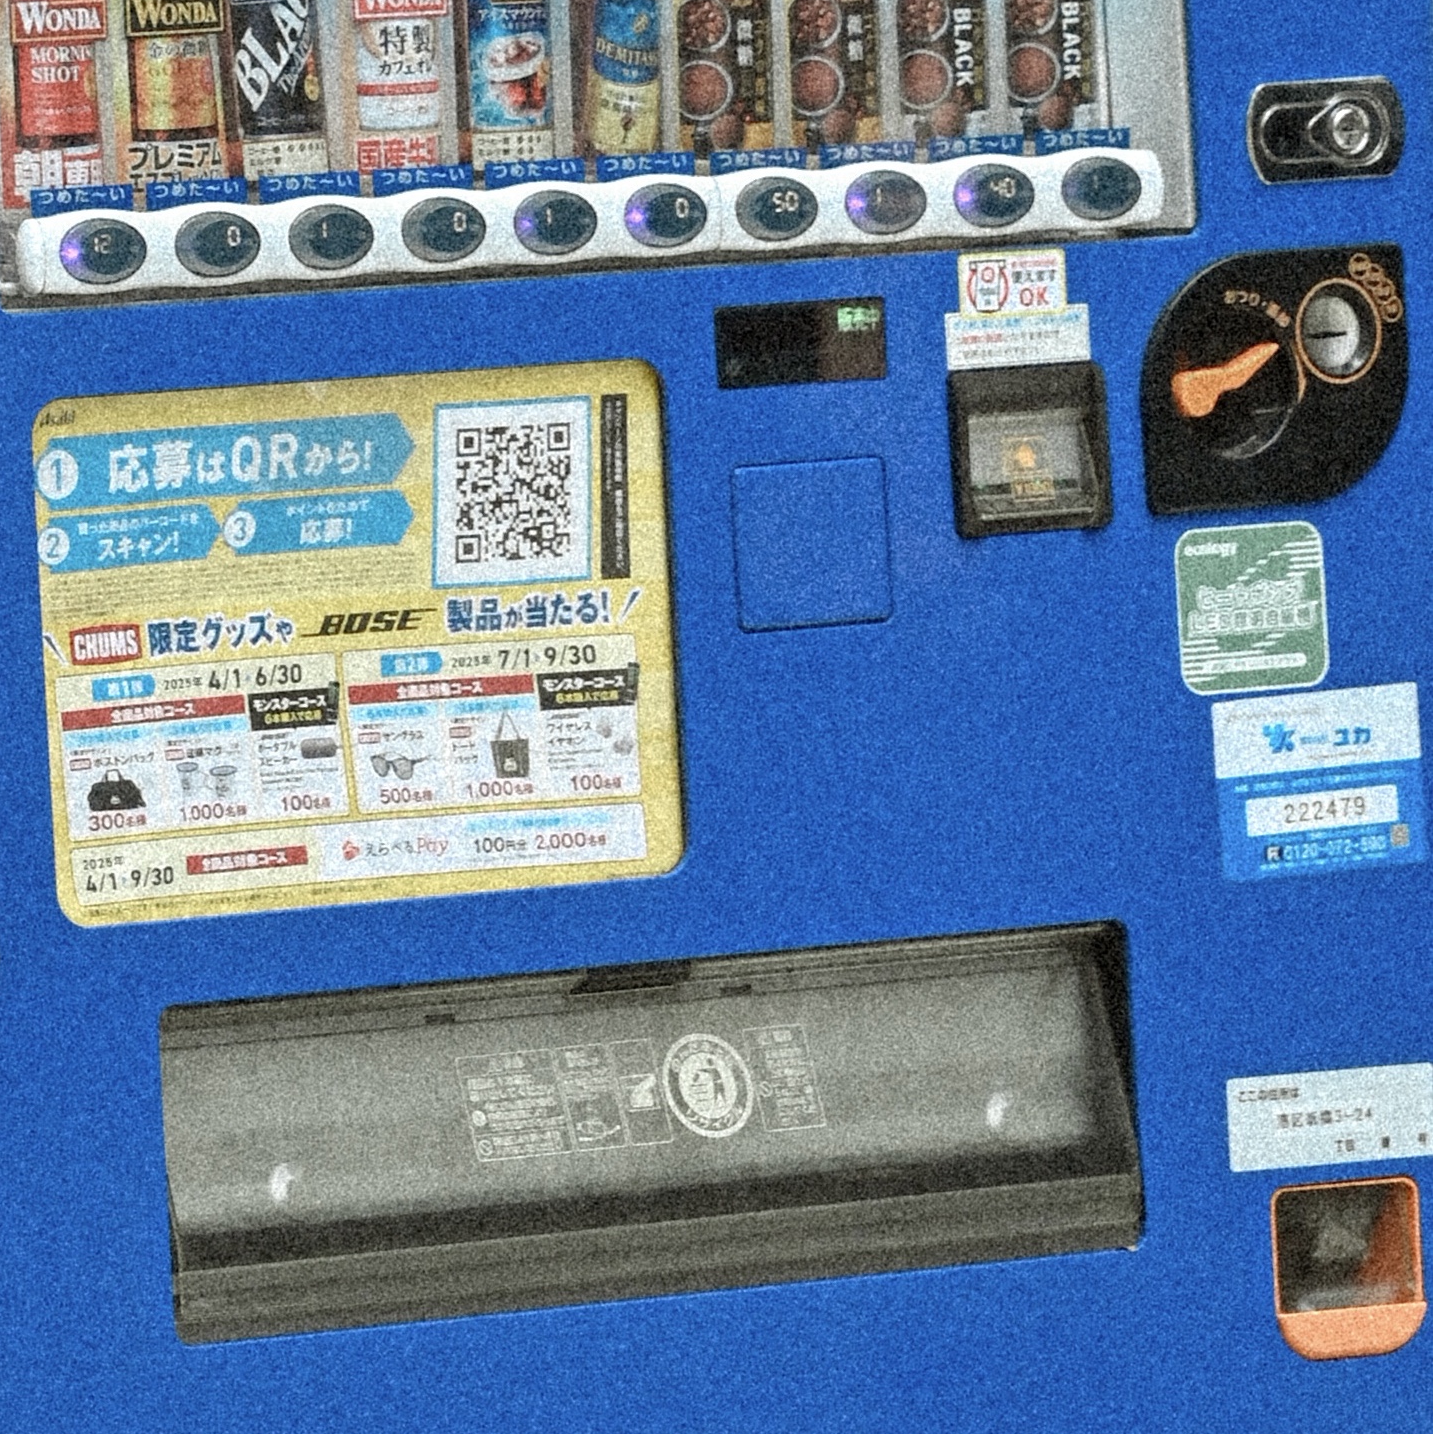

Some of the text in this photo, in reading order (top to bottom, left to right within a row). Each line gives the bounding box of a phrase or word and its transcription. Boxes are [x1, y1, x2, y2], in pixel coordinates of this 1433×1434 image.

[17, 0, 102, 35] WONDA
[380, 25, 431, 56] 特製
[952, 7, 974, 87] BLACK
[1060, 1, 1082, 81] BLACK
[30, 67, 80, 83] SHOT
[1020, 286, 1049, 307] OK
[97, 532, 179, 561] スキャン!
[73, 592, 612, 660] CHUMS 限定グッズや BOSE 製品が当たる!
[498, 648, 531, 669] 7/1
[544, 644, 597, 665] 9/30
[208, 669, 241, 691] 4/1
[256, 664, 302, 686] 6/30
[543, 677, 625, 693] モンスターコース
[252, 696, 327, 712] モンスターコース
[1284, 796, 1366, 824] 222479
[86, 867, 174, 893] 4/1 9/30
